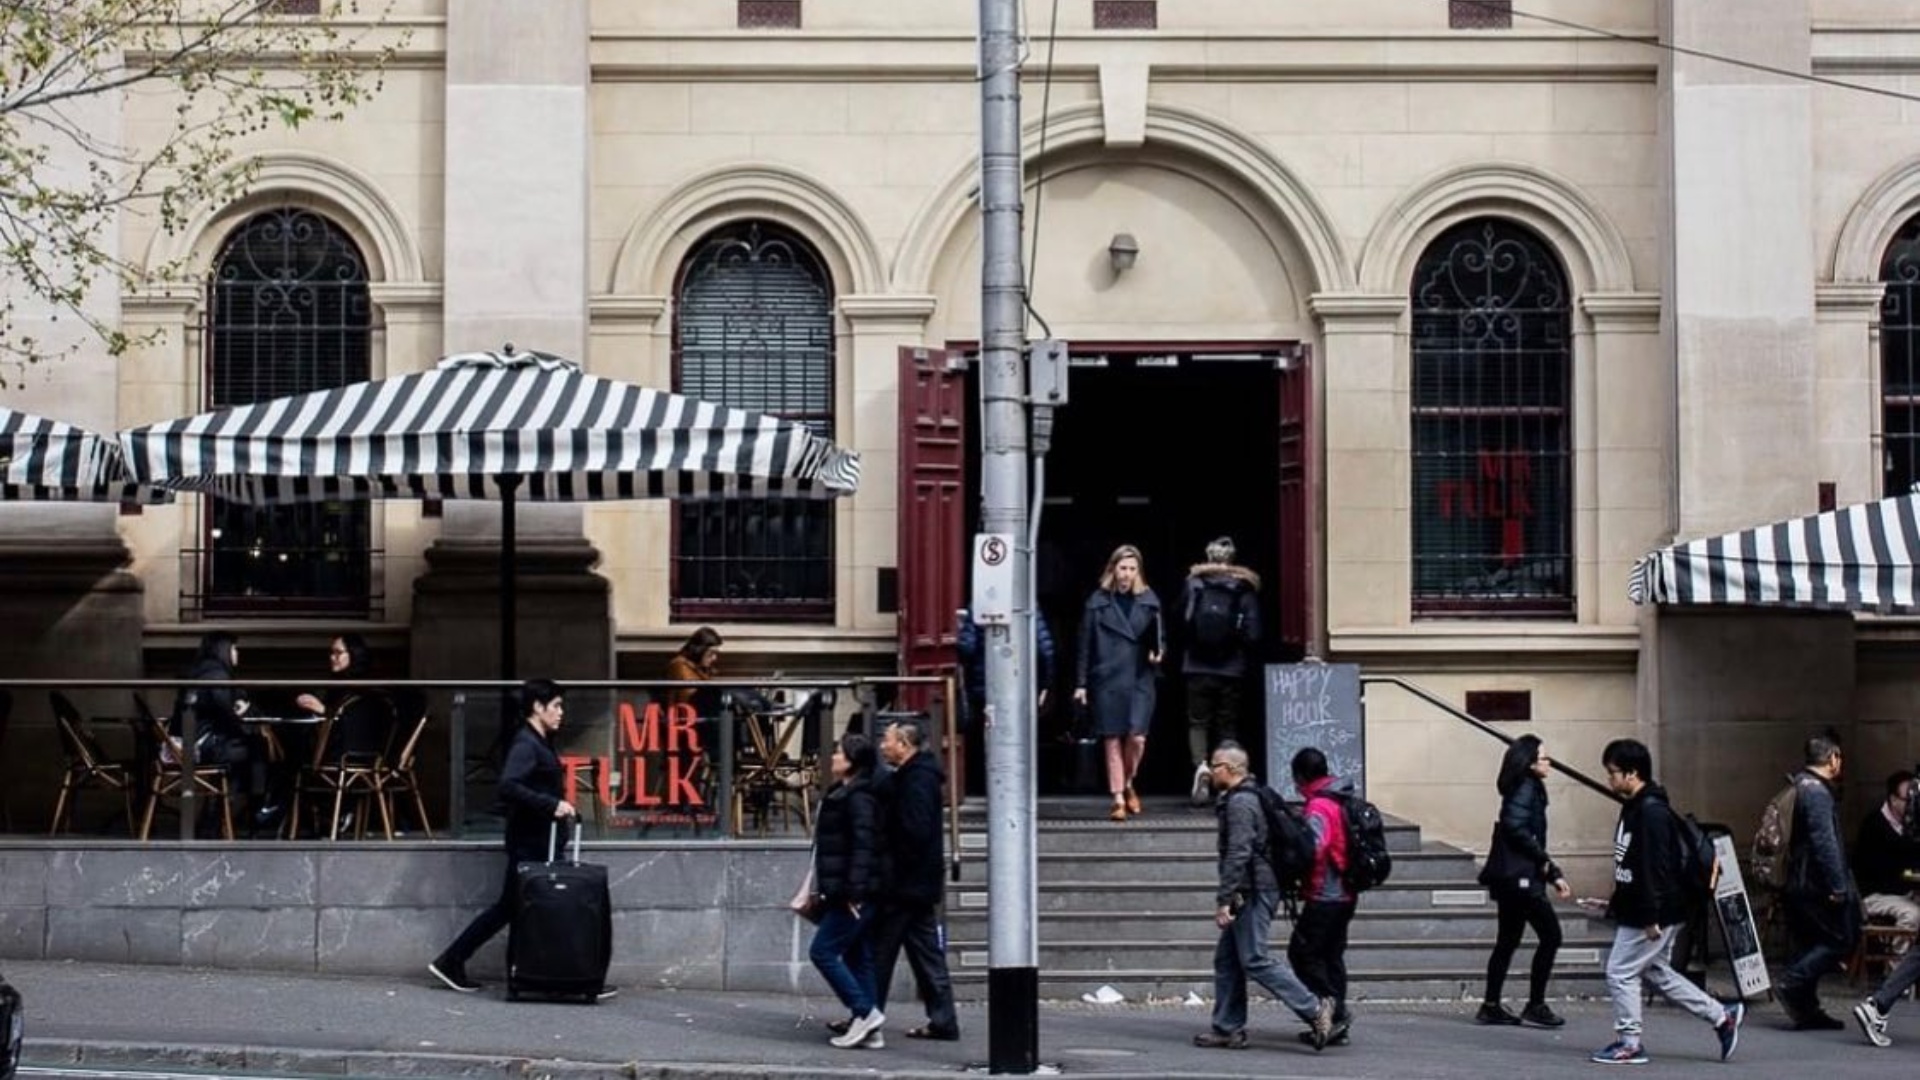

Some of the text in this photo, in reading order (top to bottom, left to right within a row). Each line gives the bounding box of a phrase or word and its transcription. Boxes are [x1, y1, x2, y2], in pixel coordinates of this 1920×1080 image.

[1478, 451, 1531, 481] MR
[1434, 478, 1534, 520] TULK
[1272, 667, 1333, 702] HAPPY
[617, 701, 702, 753] MR
[1282, 695, 1333, 725] HOUR
[560, 754, 704, 806] TULK
